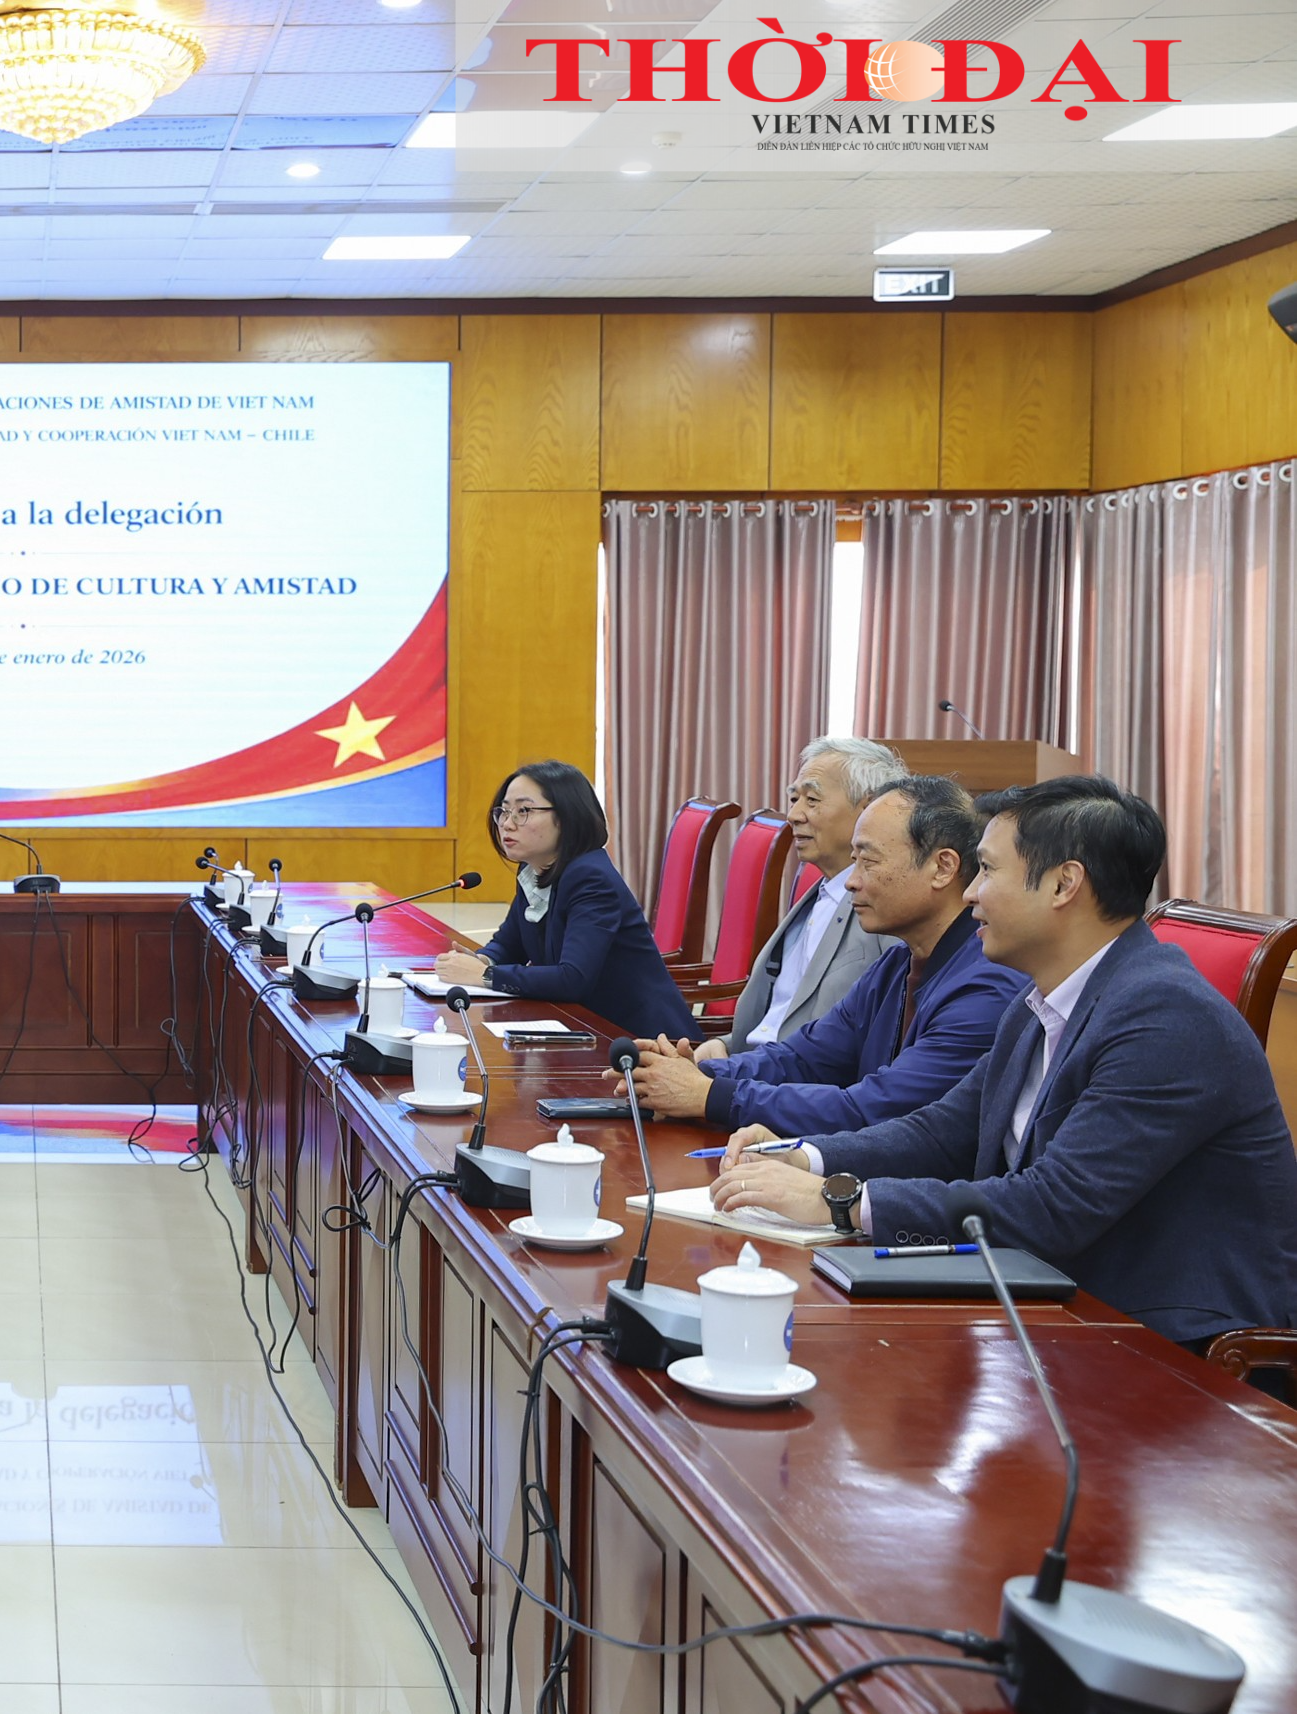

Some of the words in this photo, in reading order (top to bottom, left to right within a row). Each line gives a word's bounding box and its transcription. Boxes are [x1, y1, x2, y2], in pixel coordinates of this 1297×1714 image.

[80, 396, 104, 409] DE
[110, 396, 192, 409] AMISTAD
[198, 396, 222, 409] DE
[227, 395, 268, 409] VIET
[272, 395, 315, 409] NAM
[23, 430, 33, 442] Y
[38, 427, 157, 442] COOPERACIÓN
[162, 430, 200, 441] VIET
[204, 430, 242, 441] NAM
[262, 429, 316, 441] CHILE
[1, 508, 18, 526] a
[28, 500, 54, 526] la
[64, 500, 223, 533] delegación
[31, 577, 69, 596] DE
[76, 577, 205, 596] CULTURA
[212, 577, 229, 595] Y
[233, 577, 358, 596] AMISTAD
[13, 653, 66, 665] enero
[71, 648, 94, 665] de
[99, 649, 146, 665] 2026
